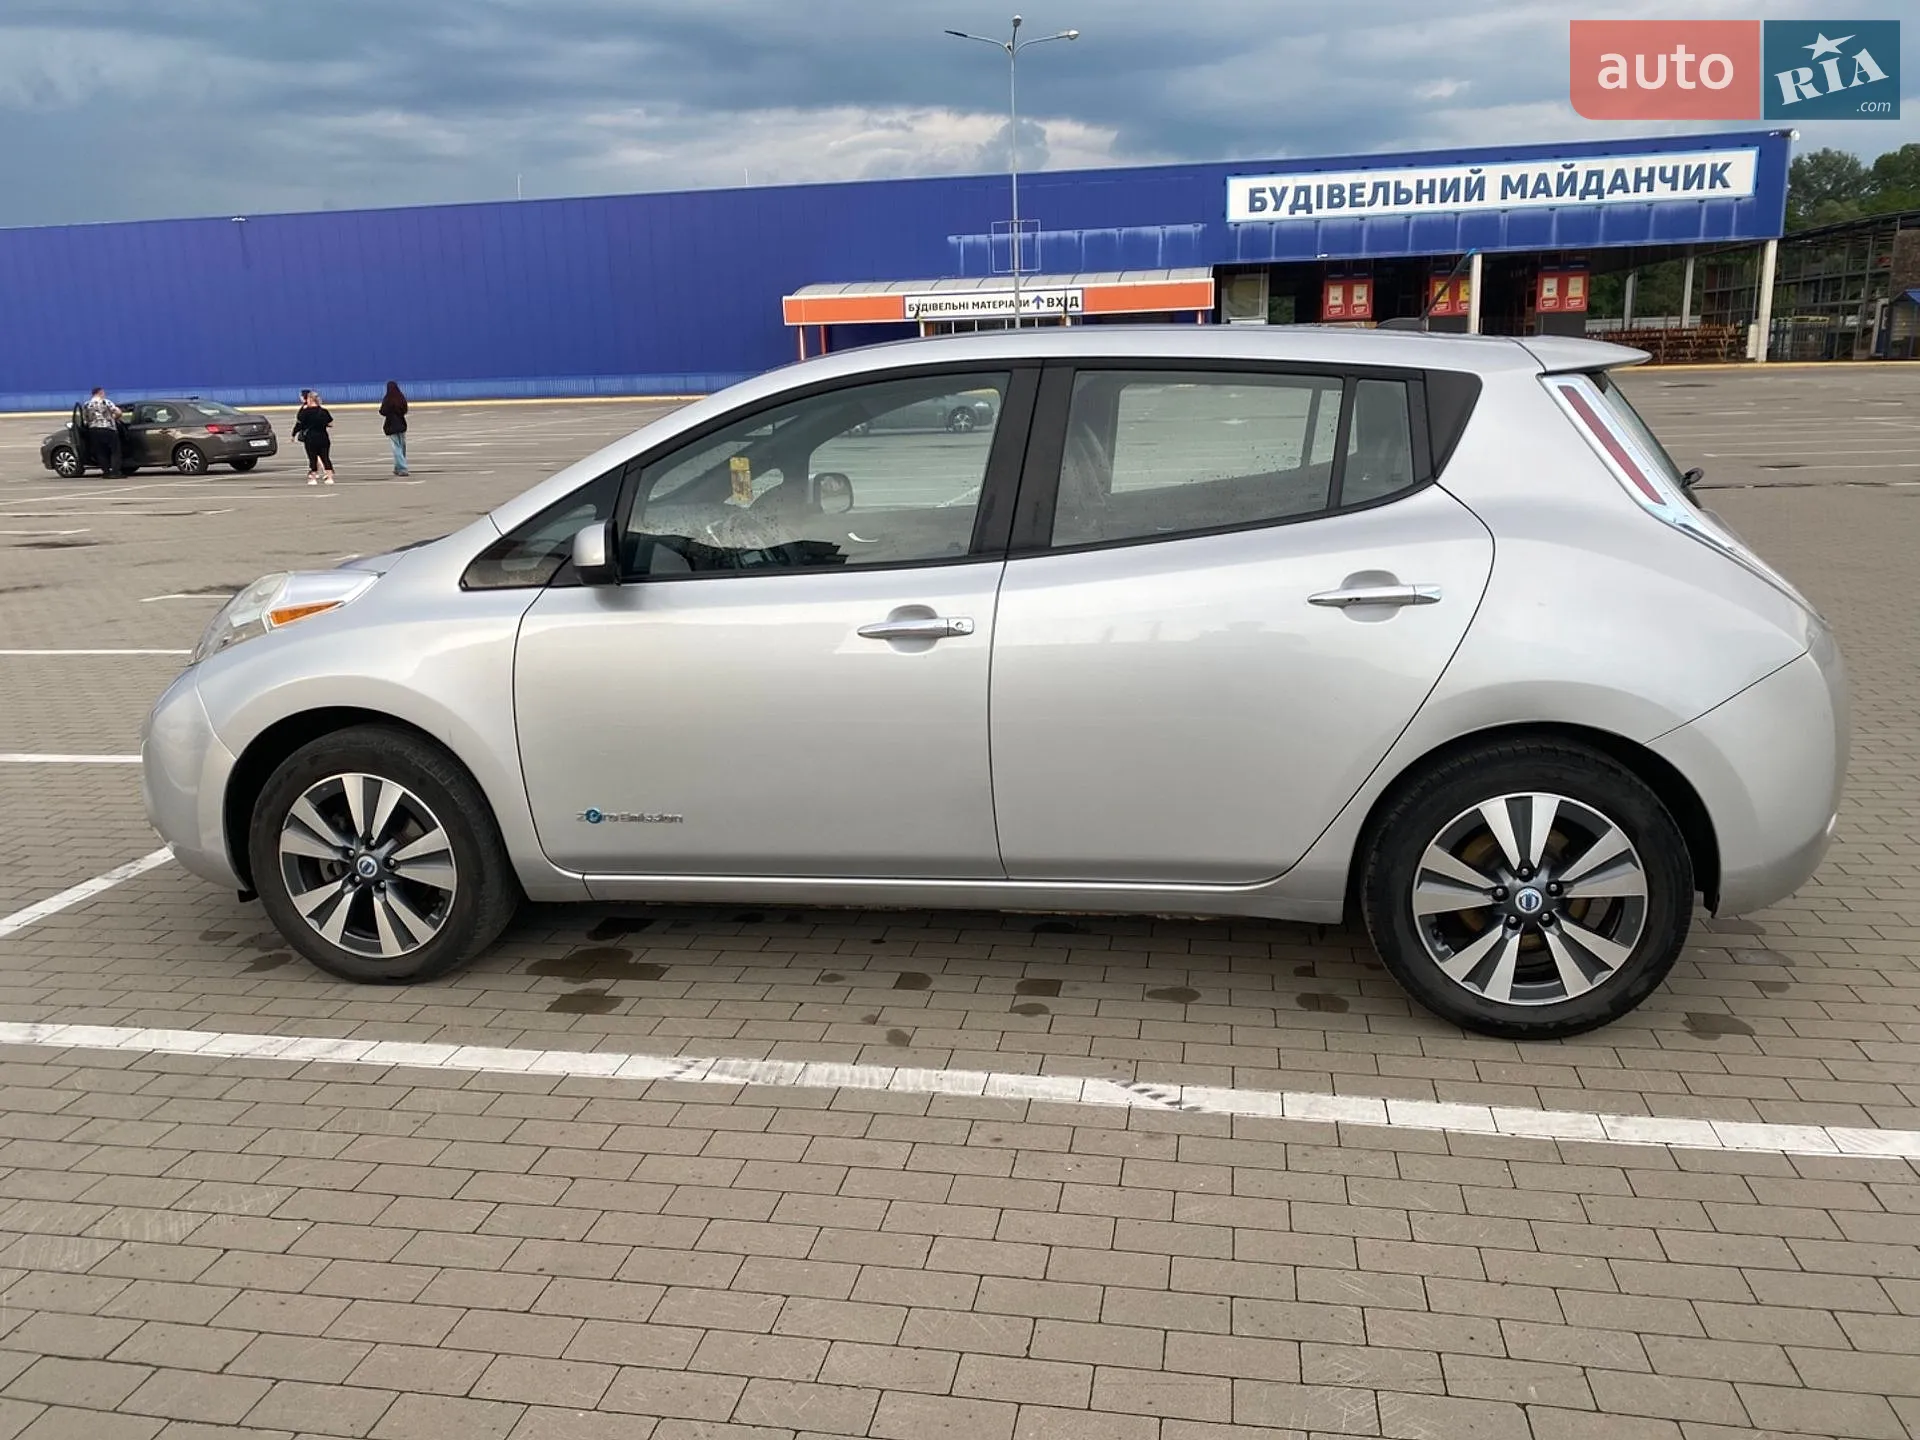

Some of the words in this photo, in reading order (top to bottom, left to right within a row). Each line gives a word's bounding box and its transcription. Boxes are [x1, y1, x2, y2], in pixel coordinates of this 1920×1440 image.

[1248, 167, 1487, 216] БУДІВЕЛЬНИЙ
[1499, 161, 1733, 201] МАЙДАНЧИК
[908, 301, 970, 313] БУДІВЕЛЬНІ
